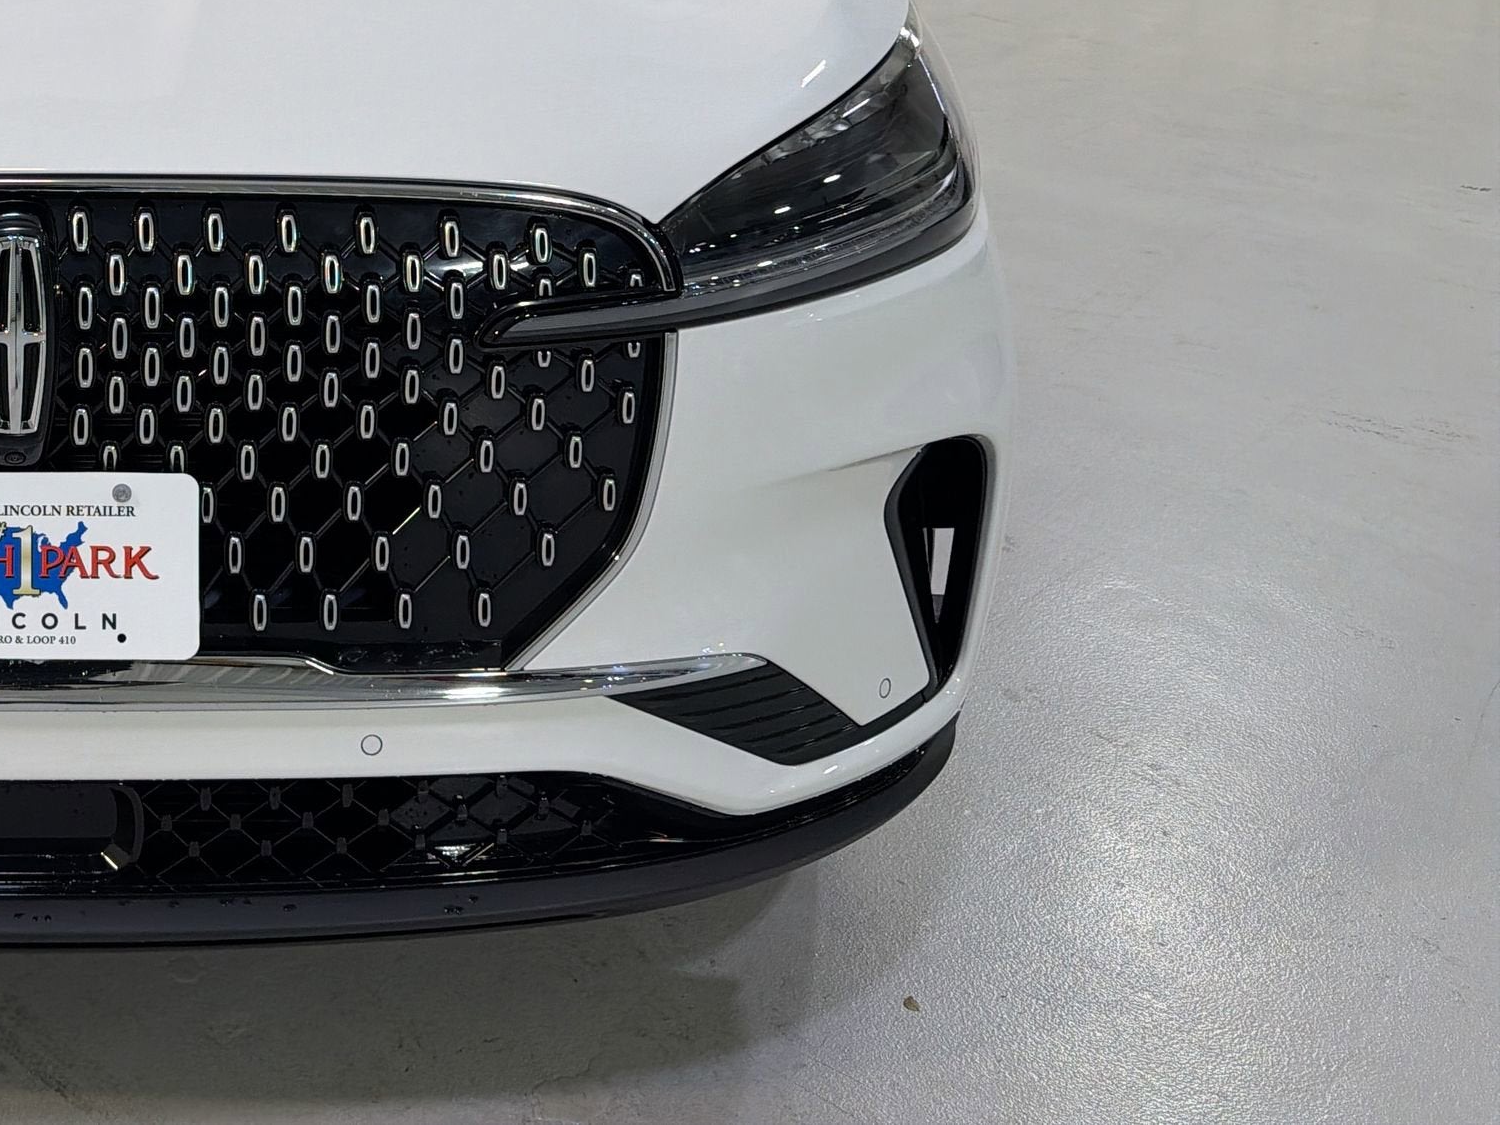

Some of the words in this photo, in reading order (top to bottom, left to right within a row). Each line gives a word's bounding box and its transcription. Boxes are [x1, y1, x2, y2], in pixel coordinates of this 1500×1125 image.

[65, 505, 137, 518] RETAILER
[39, 545, 160, 581] PARK
[15, 635, 24, 645] &
[26, 635, 56, 645] LOOP
[58, 635, 77, 645] 410
